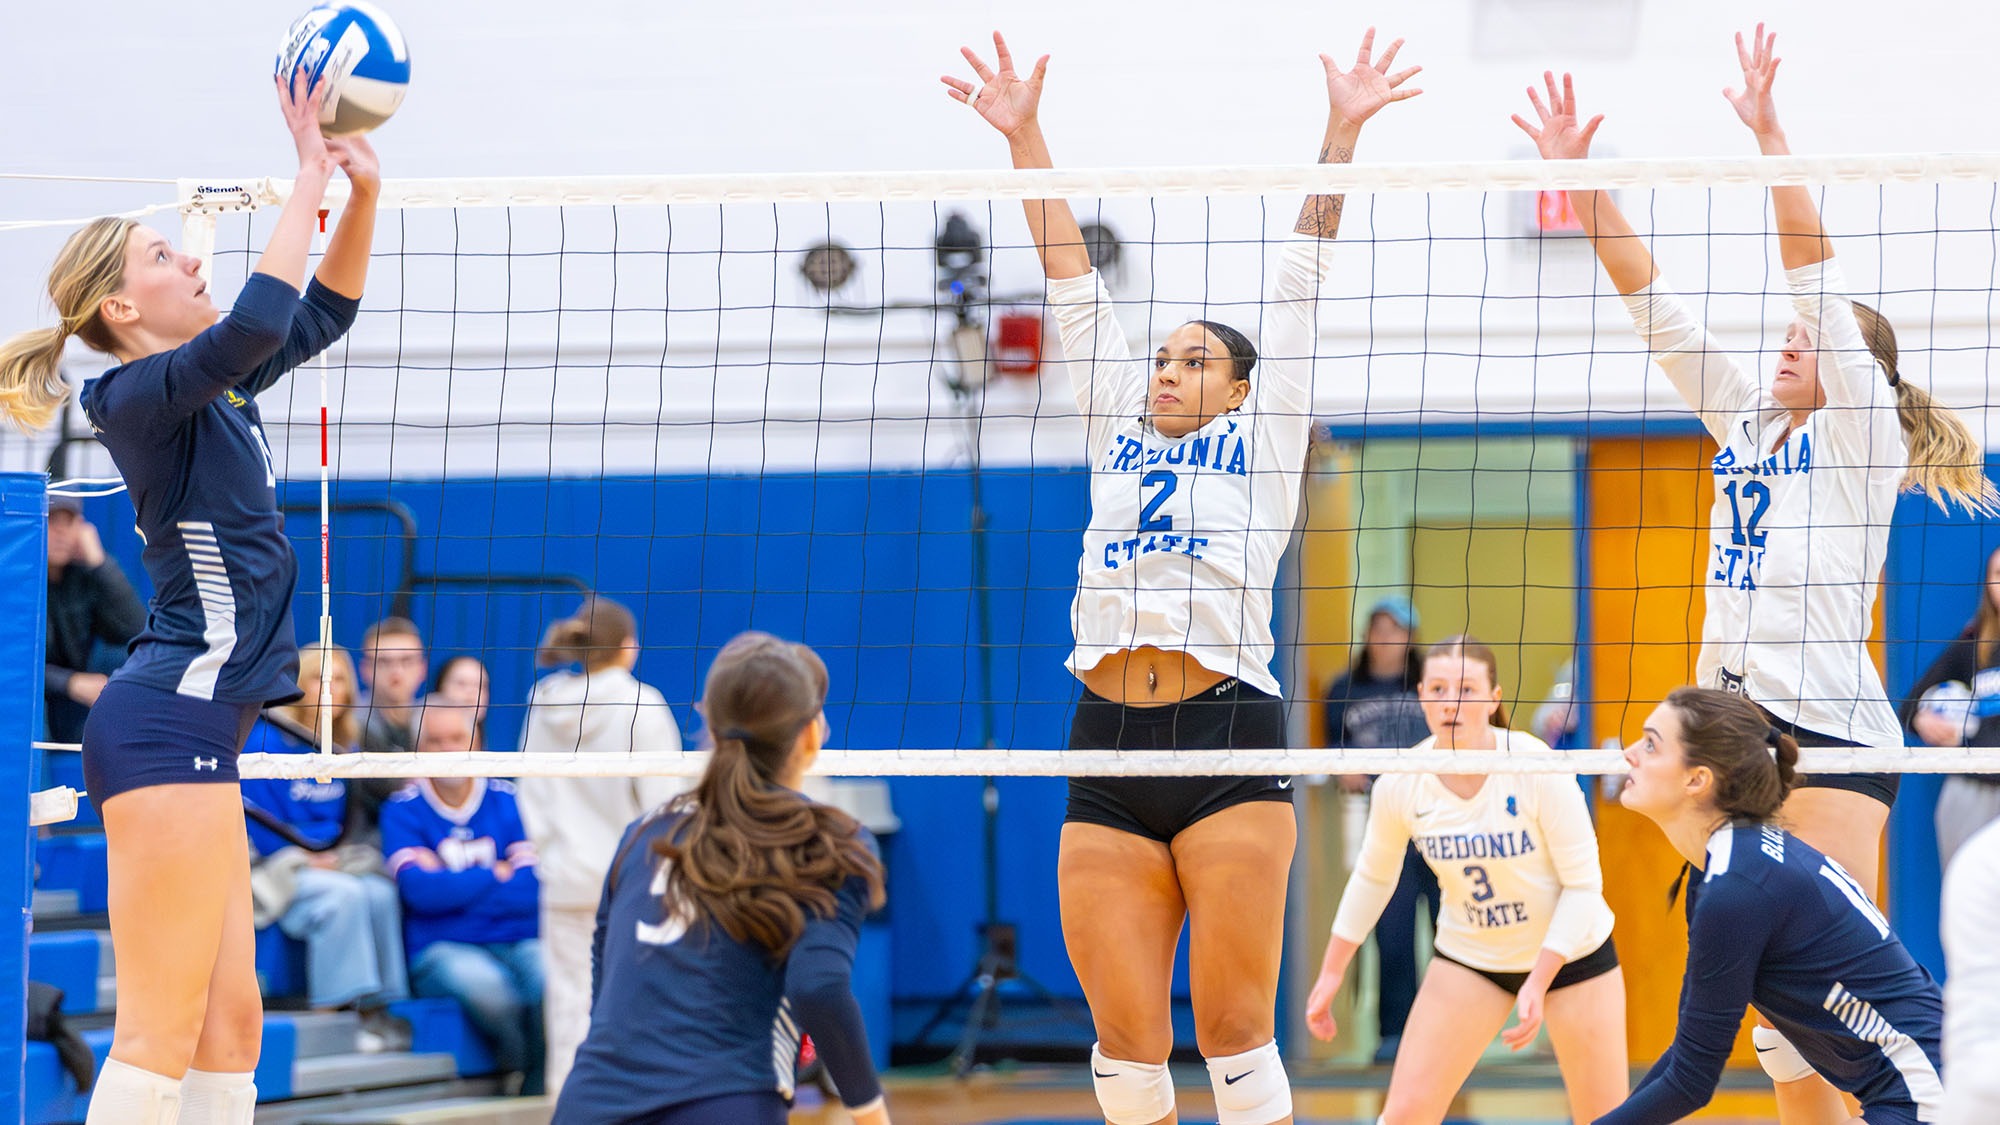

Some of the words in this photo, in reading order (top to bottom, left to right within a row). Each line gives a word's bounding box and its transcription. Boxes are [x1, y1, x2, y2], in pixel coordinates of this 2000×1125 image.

[204, 185, 243, 194] Senoh
[1138, 469, 1178, 534] 2
[1722, 479, 1772, 548] 12
[1761, 824, 1785, 864] BLU
[1463, 865, 1495, 903] 3
